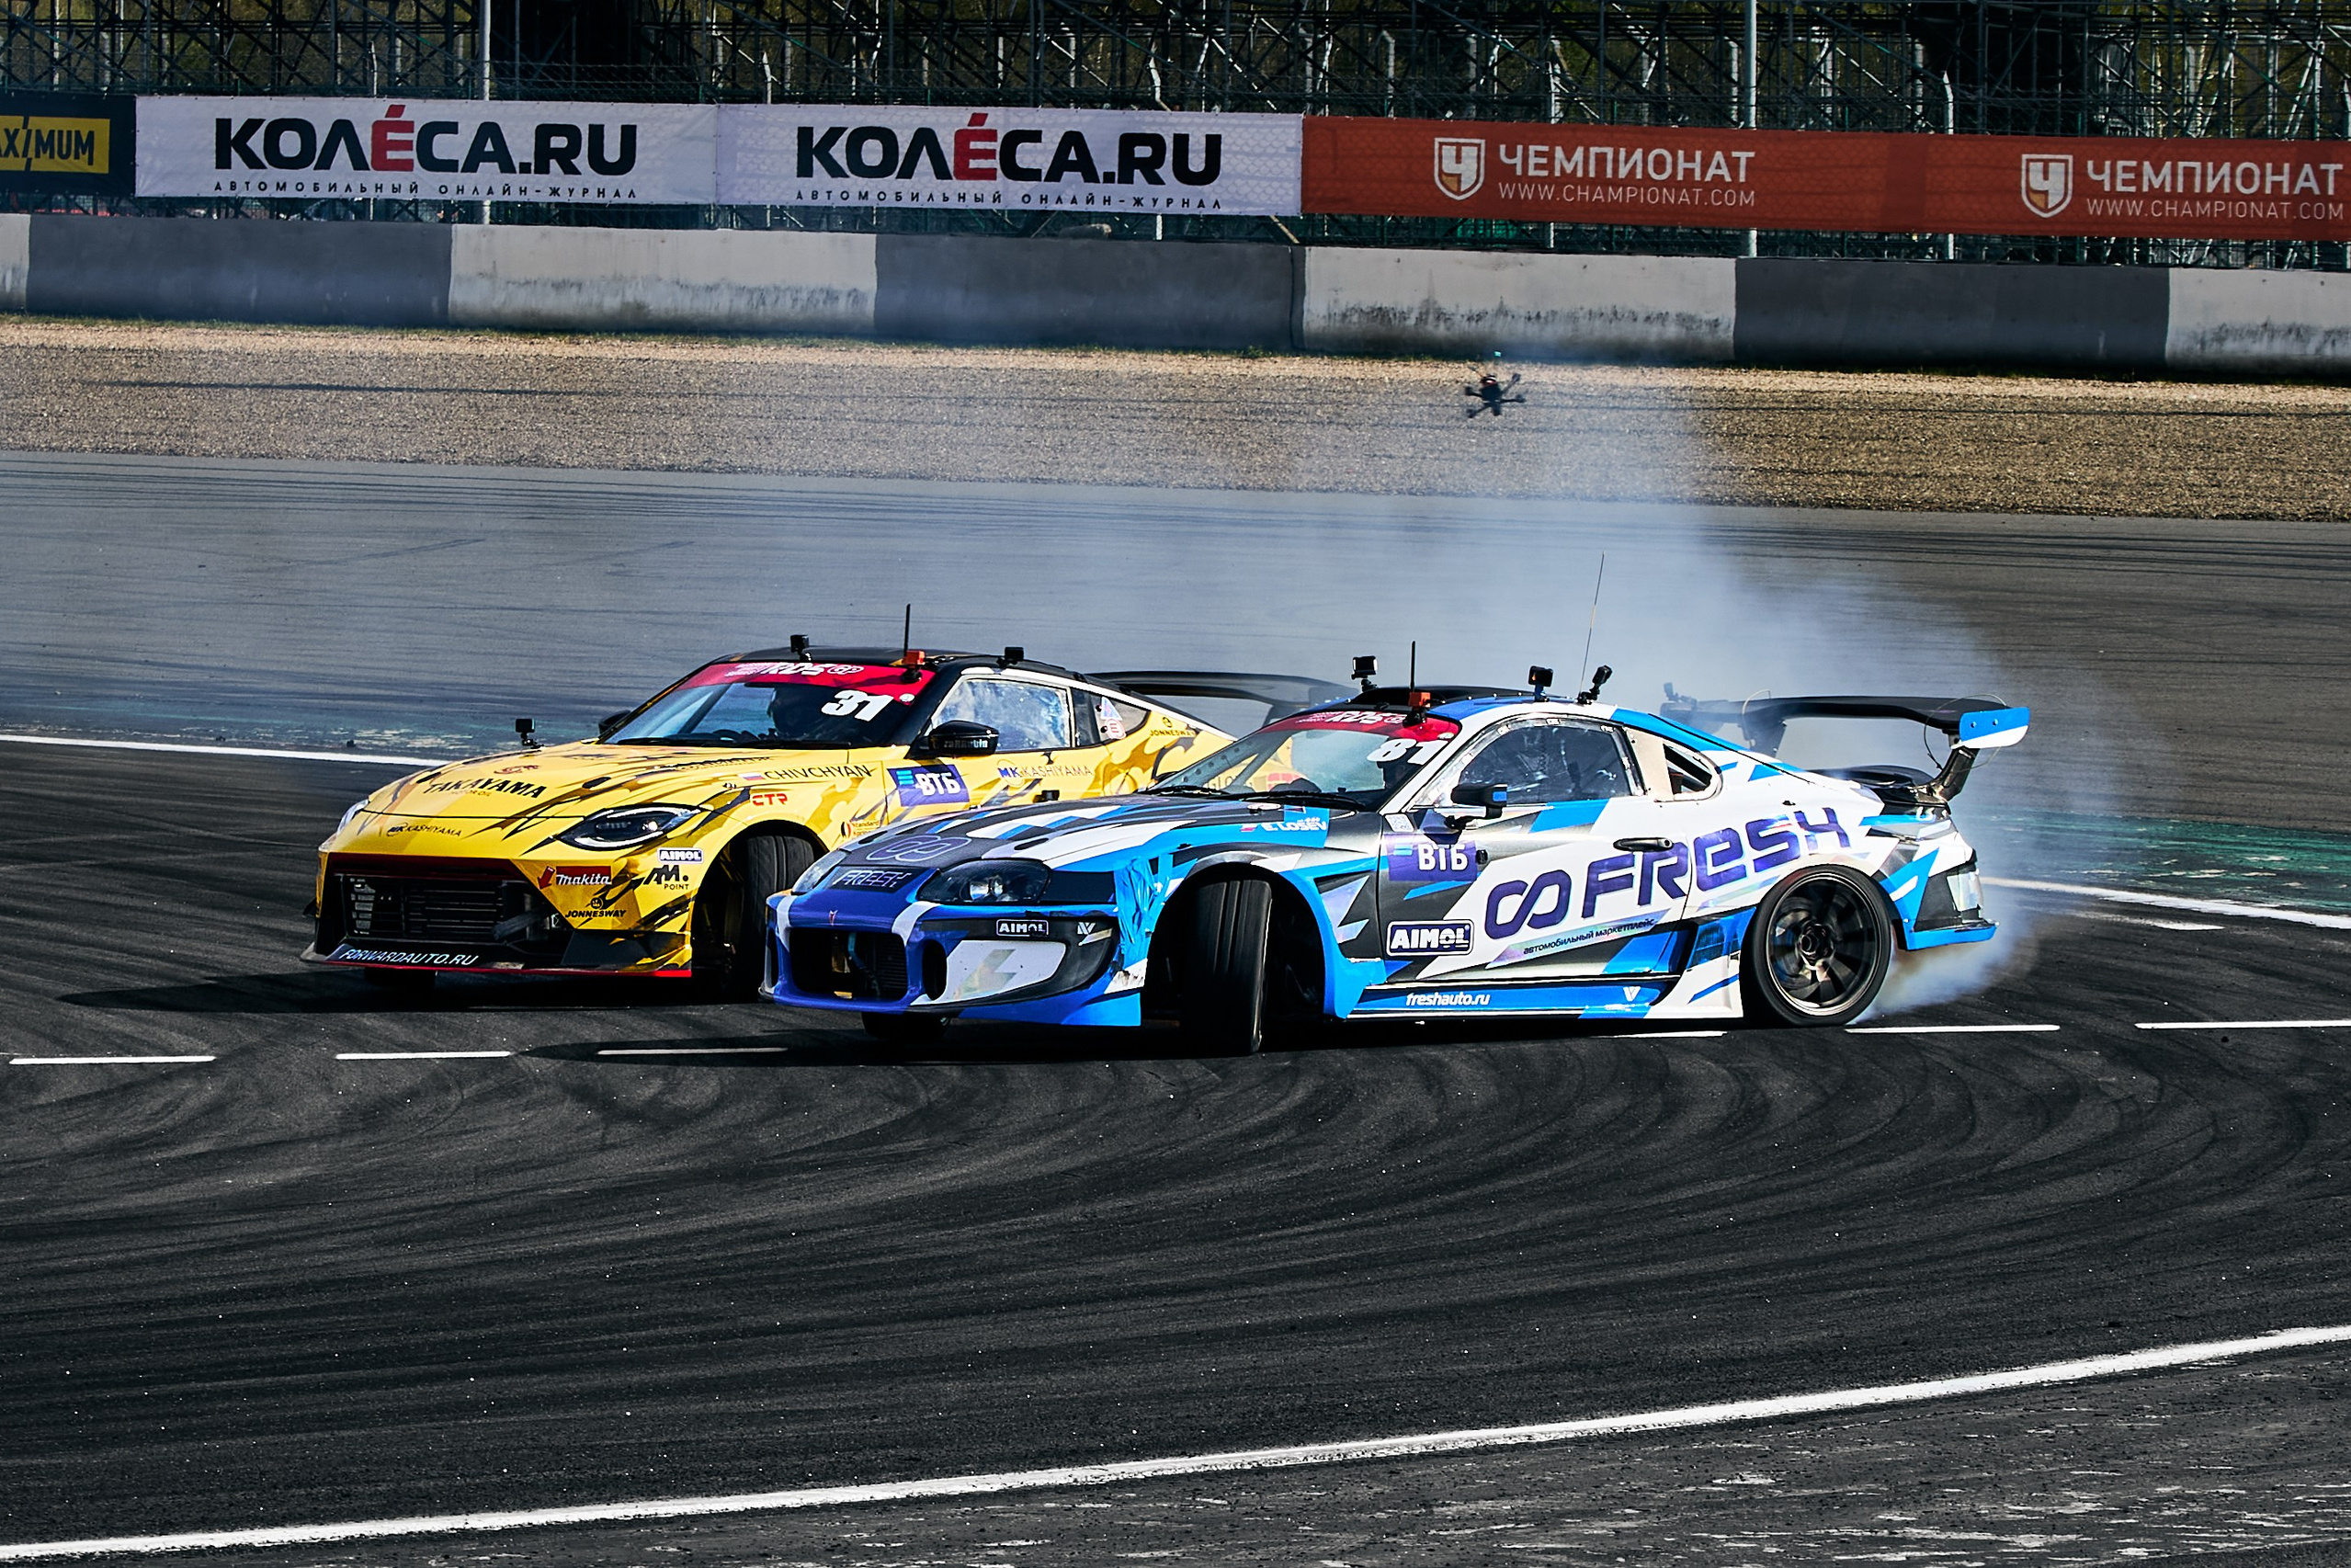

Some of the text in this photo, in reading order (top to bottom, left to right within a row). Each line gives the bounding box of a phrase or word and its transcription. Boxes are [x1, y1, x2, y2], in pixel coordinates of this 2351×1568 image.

[0, 128, 96, 166] XIMUM
[1499, 143, 1756, 183] ЧЕМПИОНАТ
[2086, 160, 2345, 196] ЧЕМПИОНАТ
[213, 181, 637, 199] АВТОМОБИЛЬНЫЙ ОНЛАЙН-ЖУРНАЛ
[796, 190, 1221, 210] АВТОМОБИЛЬНЫЙ ОНЛАЙН-ЖУРНАЛ
[1499, 182, 1756, 207] WWW.CHAMPIONAT.COM
[2086, 199, 2345, 221] WWW.CHAMPIONAT.COM
[821, 689, 894, 722] 31
[1366, 738, 1449, 765] 81
[764, 765, 872, 780] CHIVCHYAN
[1023, 765, 1095, 778] KASHIYAMA
[424, 778, 548, 799] TAKAYAMA
[914, 771, 961, 797] ВТБ
[752, 792, 789, 807] CTR
[660, 850, 702, 861] AIMOL
[1417, 844, 1469, 870] ВТБ
[564, 909, 627, 918] JONNESWAY
[1390, 927, 1470, 949] AIMOL
[1523, 918, 1655, 955] автомобильный маркетплейс
[338, 949, 479, 965] FORWARDAUTO.RU
[1405, 992, 1491, 1006] freshauto.ru
